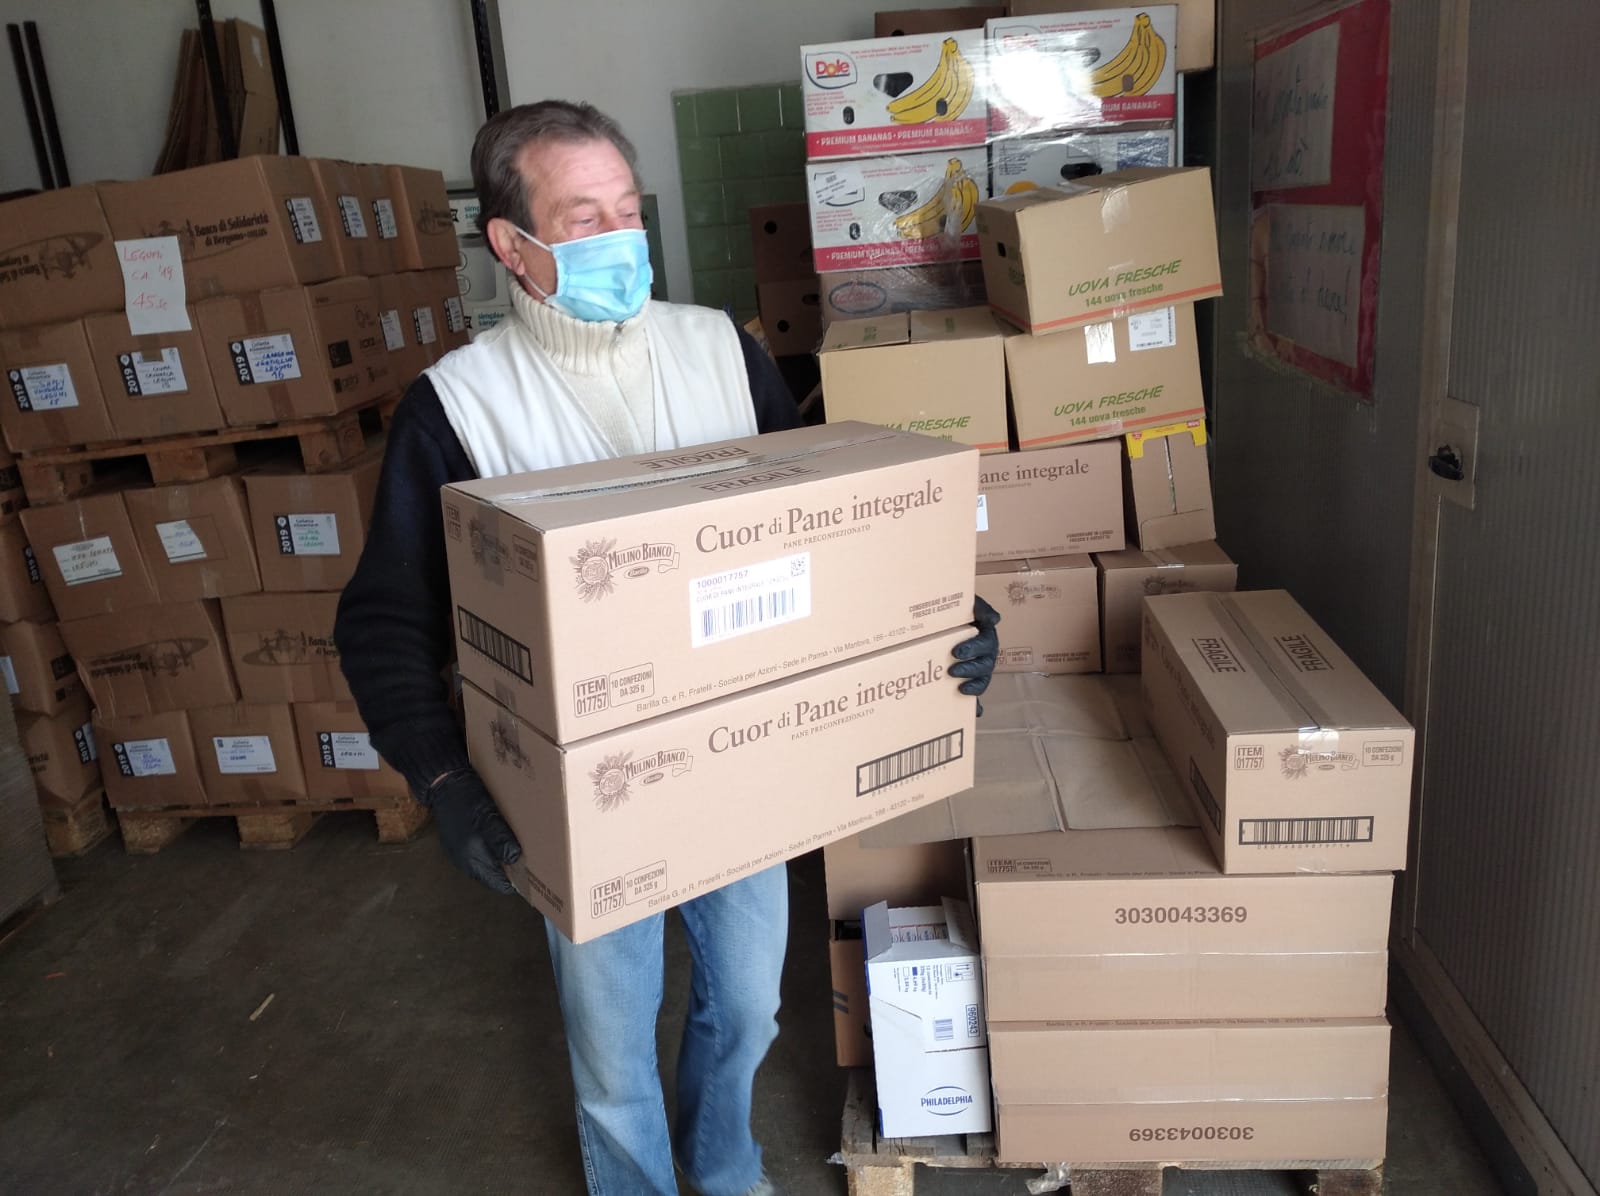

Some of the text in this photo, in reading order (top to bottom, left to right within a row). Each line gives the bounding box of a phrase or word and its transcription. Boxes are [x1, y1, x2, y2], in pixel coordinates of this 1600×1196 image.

[816, 58, 850, 76] Dole
[820, 134, 856, 146] PREMIUM
[858, 131, 893, 144] BANANAS
[897, 128, 933, 141] PREMIUM
[1068, 260, 1182, 296] UOVA FRESCHE
[132, 292, 155, 310] 45
[1086, 298, 1102, 308] 144
[1128, 282, 1164, 298] fresche
[236, 356, 250, 382] 2019
[124, 368, 138, 394] 2019
[14, 383, 29, 409] 2019
[1054, 385, 1164, 416] UOVA FRESCHE
[908, 416, 971, 432] FRESCHE
[1070, 405, 1146, 427] 144 uova fresche
[700, 466, 813, 493] FRAGILE
[980, 458, 1090, 484] ane integrale
[696, 479, 944, 554] Cuor di Pane integrale
[280, 529, 292, 552] 2019
[783, 524, 871, 550] PANE PRECONFEZIONATO
[608, 543, 673, 570] MULINO BIANCO
[697, 569, 748, 588] 1000017757
[908, 596, 941, 613] CONSERVARE
[942, 595, 947, 604] IN
[912, 608, 932, 619] FRESCO
[1196, 637, 1240, 674] FRAGILE
[1282, 634, 1328, 672] FRAGILE
[612, 671, 652, 689] 10 CONFEZIONI
[636, 701, 660, 712] Barilla
[662, 696, 670, 704] G.
[679, 691, 687, 700] R.
[688, 682, 712, 696] Fratelli
[718, 674, 744, 688] Società
[745, 672, 756, 682] per
[757, 662, 778, 676] Azioni
[782, 658, 799, 669] Sede
[800, 656, 806, 664] in
[808, 650, 828, 664] Parma
[832, 645, 844, 654] Via
[844, 638, 871, 651] Mantova,
[576, 679, 606, 697] ITEM
[620, 685, 645, 697] DA 325 g
[576, 692, 607, 714] 017757
[708, 660, 944, 754] Cuor di Pane integrale
[791, 708, 876, 741] PANE PRECONFEZIONATO
[78, 742, 90, 763] 2019
[322, 744, 332, 766] 2019
[1237, 747, 1262, 756] ITEM
[1306, 753, 1330, 764] MULINO
[118, 754, 132, 775] 2019
[624, 750, 686, 780] MULINO BIANCO
[1236, 757, 1263, 769] 017757
[648, 894, 670, 908] Barilla
[672, 888, 680, 899] G.
[688, 882, 696, 892] R.
[698, 872, 722, 888] Fratelli
[726, 862, 750, 877] Società
[751, 858, 762, 870] per
[764, 848, 784, 862] Azioni
[788, 840, 805, 852] Sede
[806, 838, 812, 846] in
[812, 830, 833, 844] Parma
[836, 823, 847, 834] Via
[626, 868, 665, 888] 10 CONFEZIONI
[634, 886, 642, 896] DA
[643, 882, 654, 894] 325
[593, 880, 621, 899] ITEM
[593, 892, 622, 916] 017757
[1114, 906, 1248, 925] 3030043369
[968, 1006, 978, 1034] 960243
[920, 1094, 974, 1108] PHILADELPHIA
[1128, 1125, 1256, 1142] 3030043369
